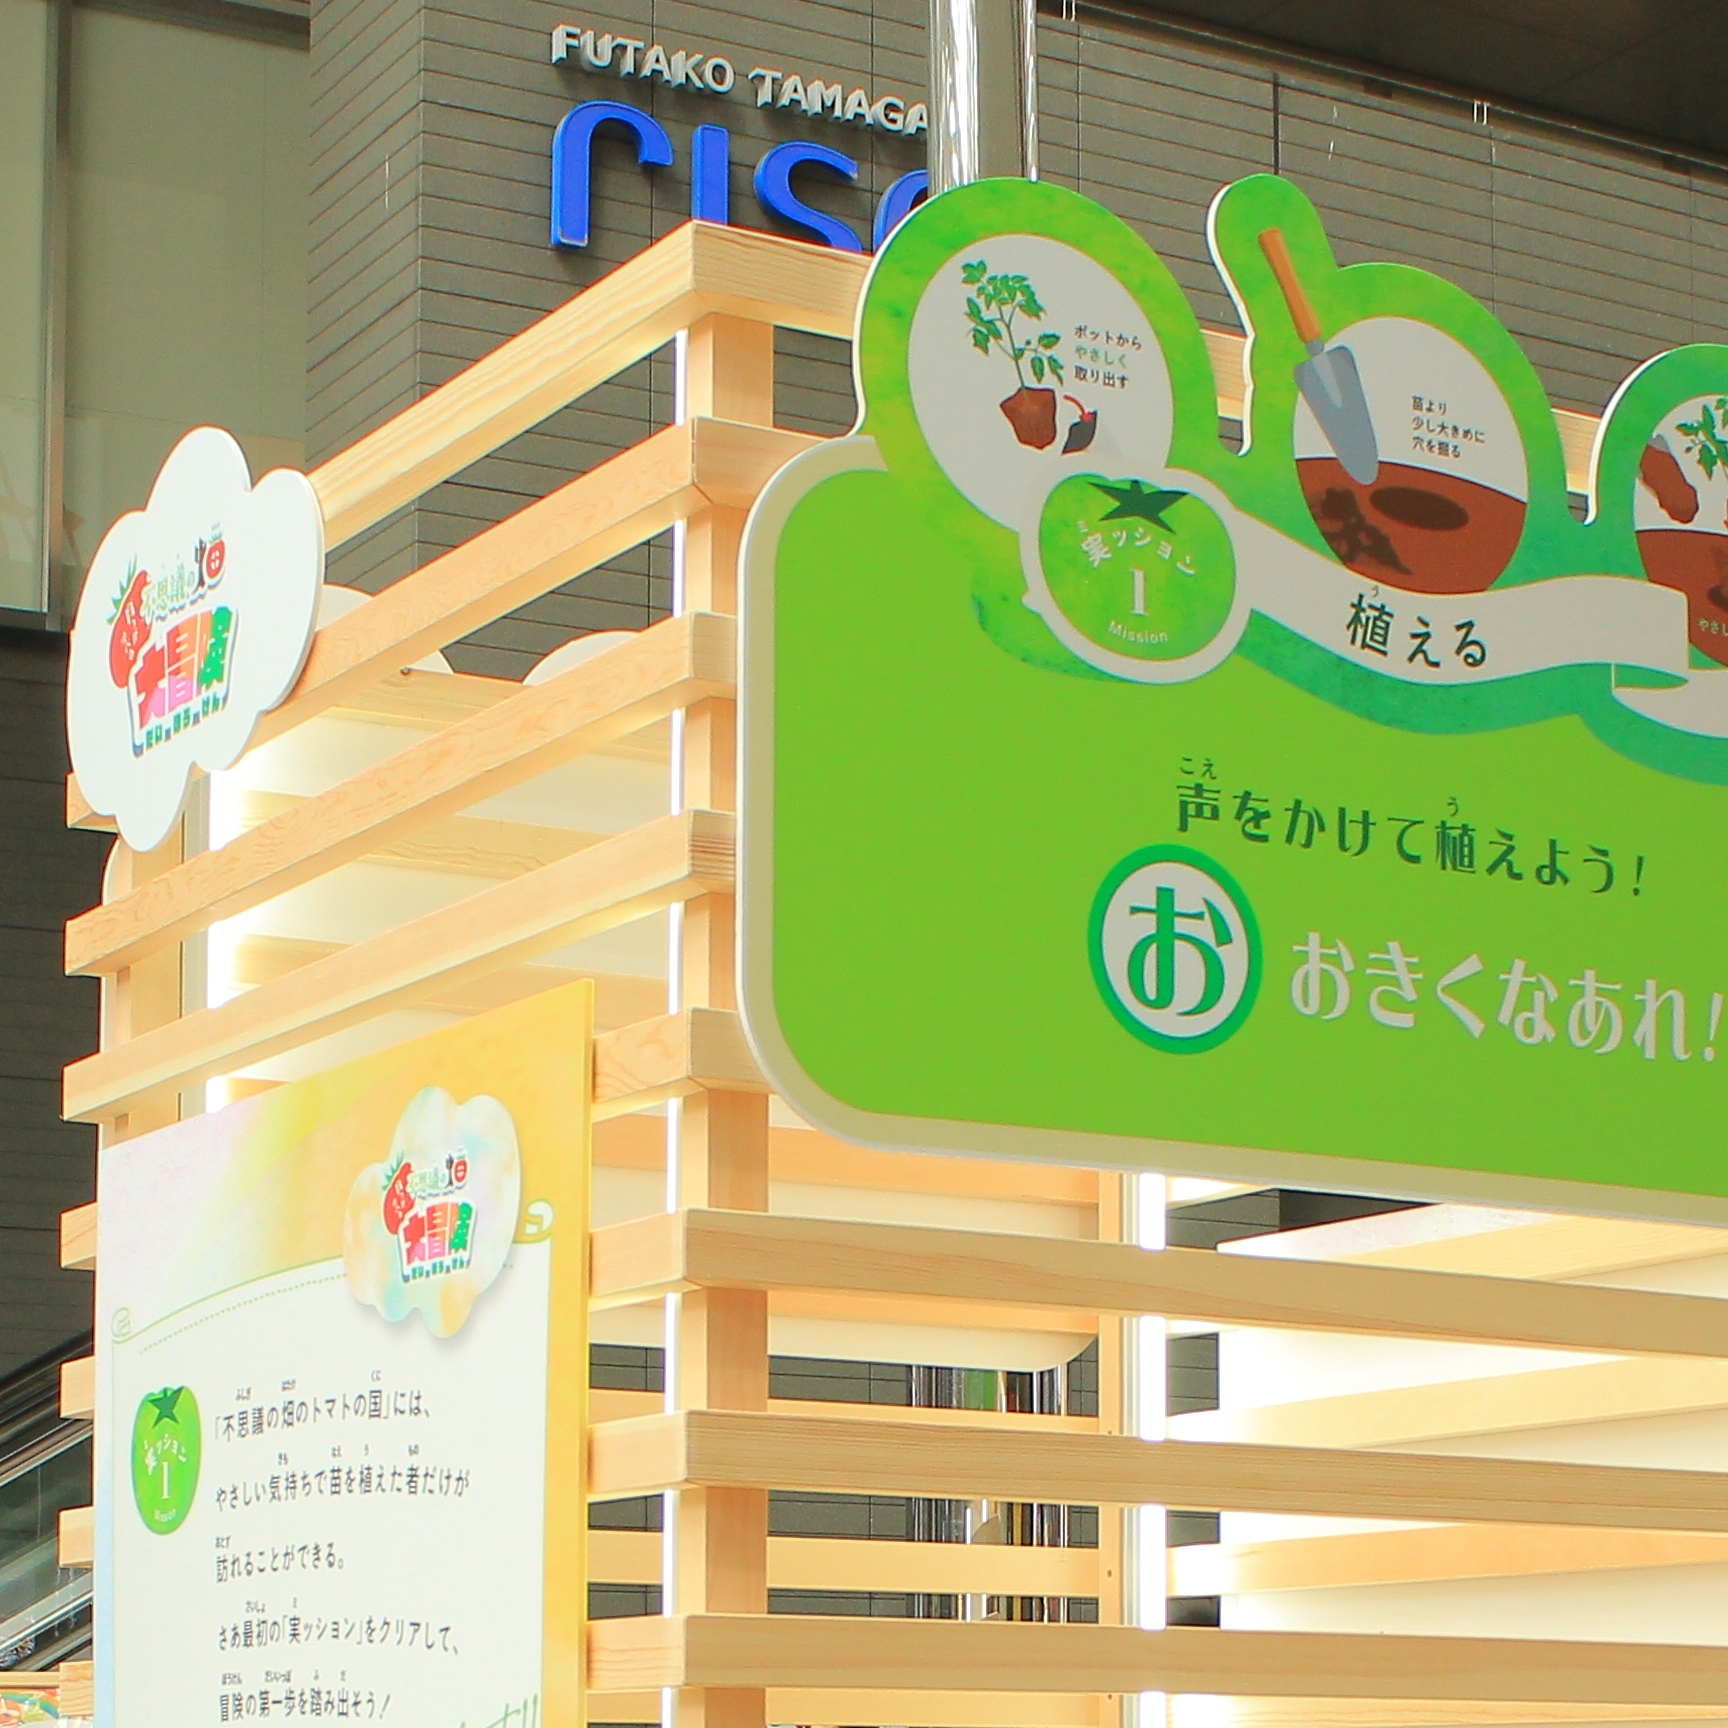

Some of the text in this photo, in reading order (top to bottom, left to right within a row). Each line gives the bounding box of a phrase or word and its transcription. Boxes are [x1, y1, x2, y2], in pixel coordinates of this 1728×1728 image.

[551, 23, 734, 94] FUTAKO
[1074, 323, 1143, 351] ポットから
[1074, 345, 1128, 369] やさしく
[1073, 365, 1130, 390] 取り出す
[1412, 394, 1448, 416] 苗より
[1412, 415, 1486, 445] 少し大きめに
[1412, 434, 1462, 459] 穴を掘る
[1108, 619, 1169, 644] Mission
[1345, 594, 1488, 669] 植える
[1177, 782, 1647, 897] 声をかけて植えよう！
[1126, 884, 1726, 1063] お おきくなあれ！
[214, 1388, 431, 1443] 「不思議の畑のトマトの国」には、
[215, 1464, 470, 1512] やさしい気持ちで苗を植えた者だけが
[216, 1541, 344, 1583] 訪れることができる。
[218, 1613, 460, 1656] さあ最初の「実ッション」をクリアして、
[219, 1687, 392, 1722] 冒険の第一歩を踏み出そう！
